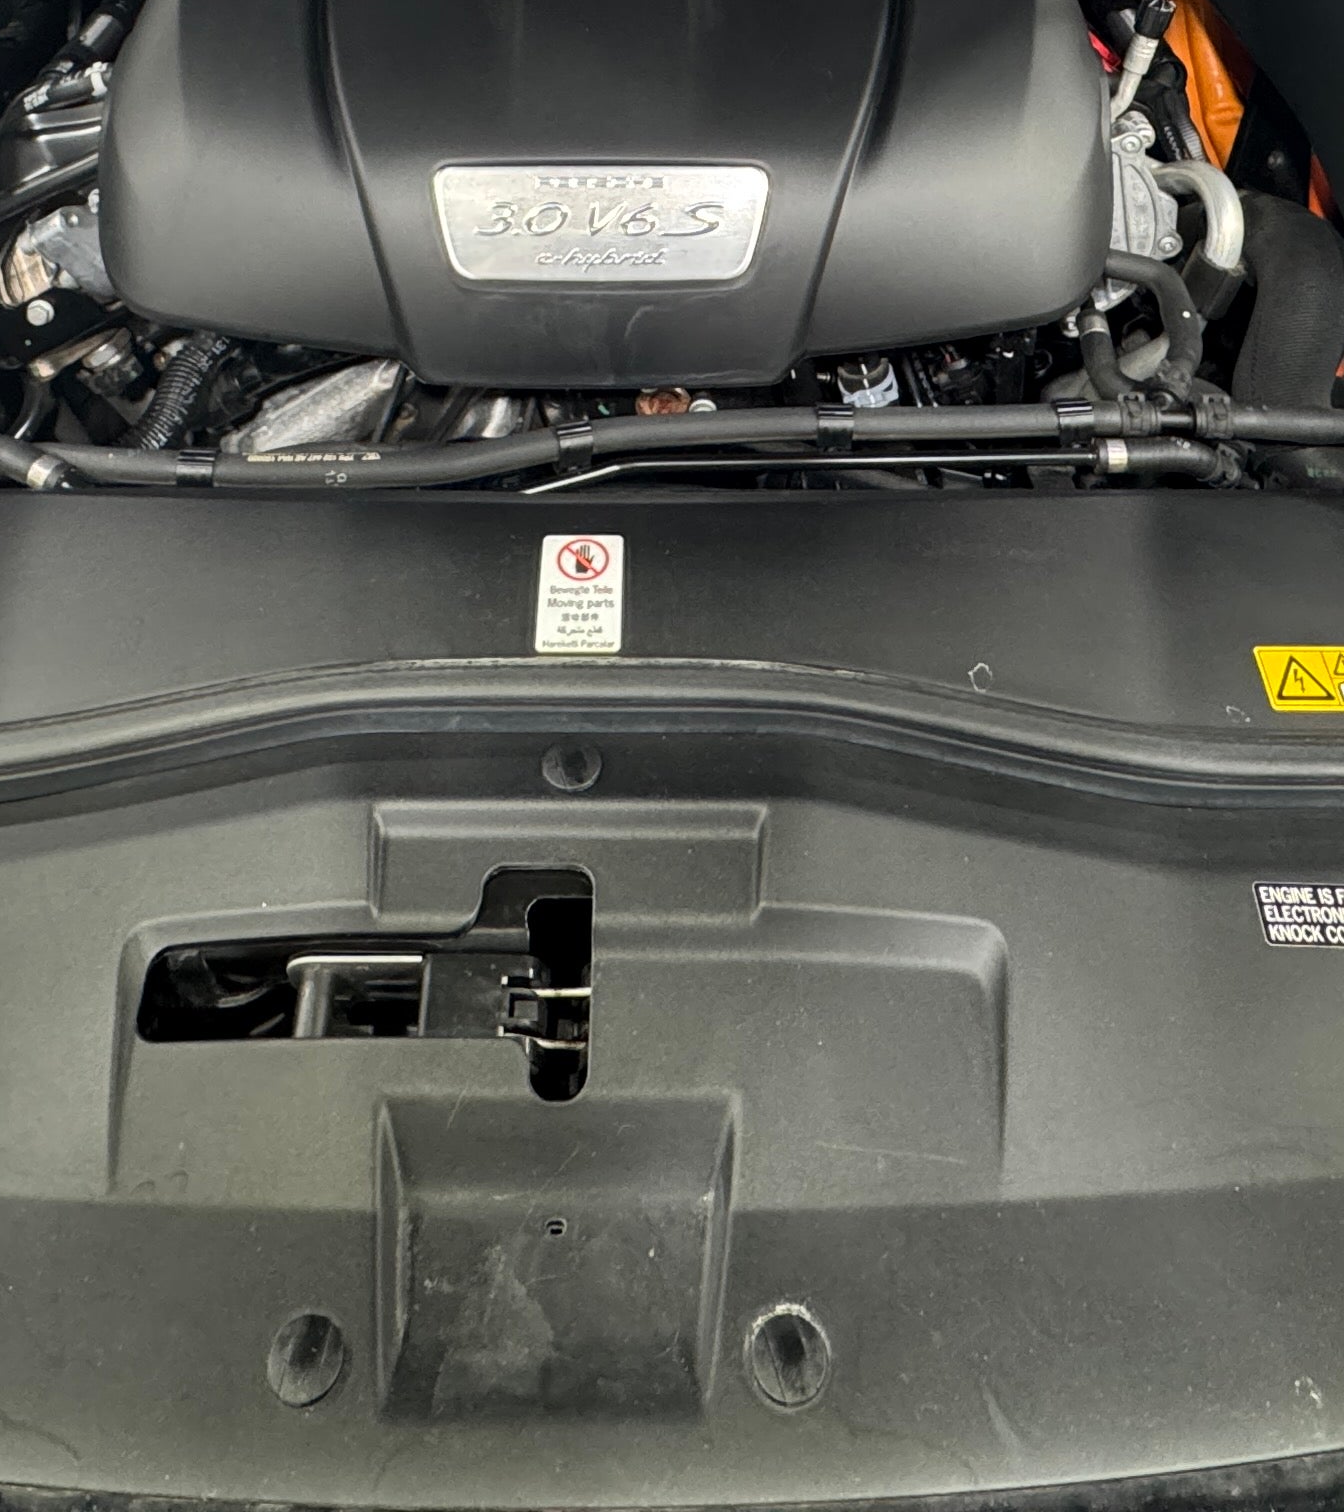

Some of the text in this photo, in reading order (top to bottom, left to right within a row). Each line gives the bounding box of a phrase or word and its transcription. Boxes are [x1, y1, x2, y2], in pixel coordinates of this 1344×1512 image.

[473, 201, 724, 237] 3.0 V6 S
[547, 598, 614, 609] Moving parts
[1258, 886, 1316, 904] ENGINE
[1318, 888, 1334, 905] IS
[1267, 925, 1325, 943] KNOCK
